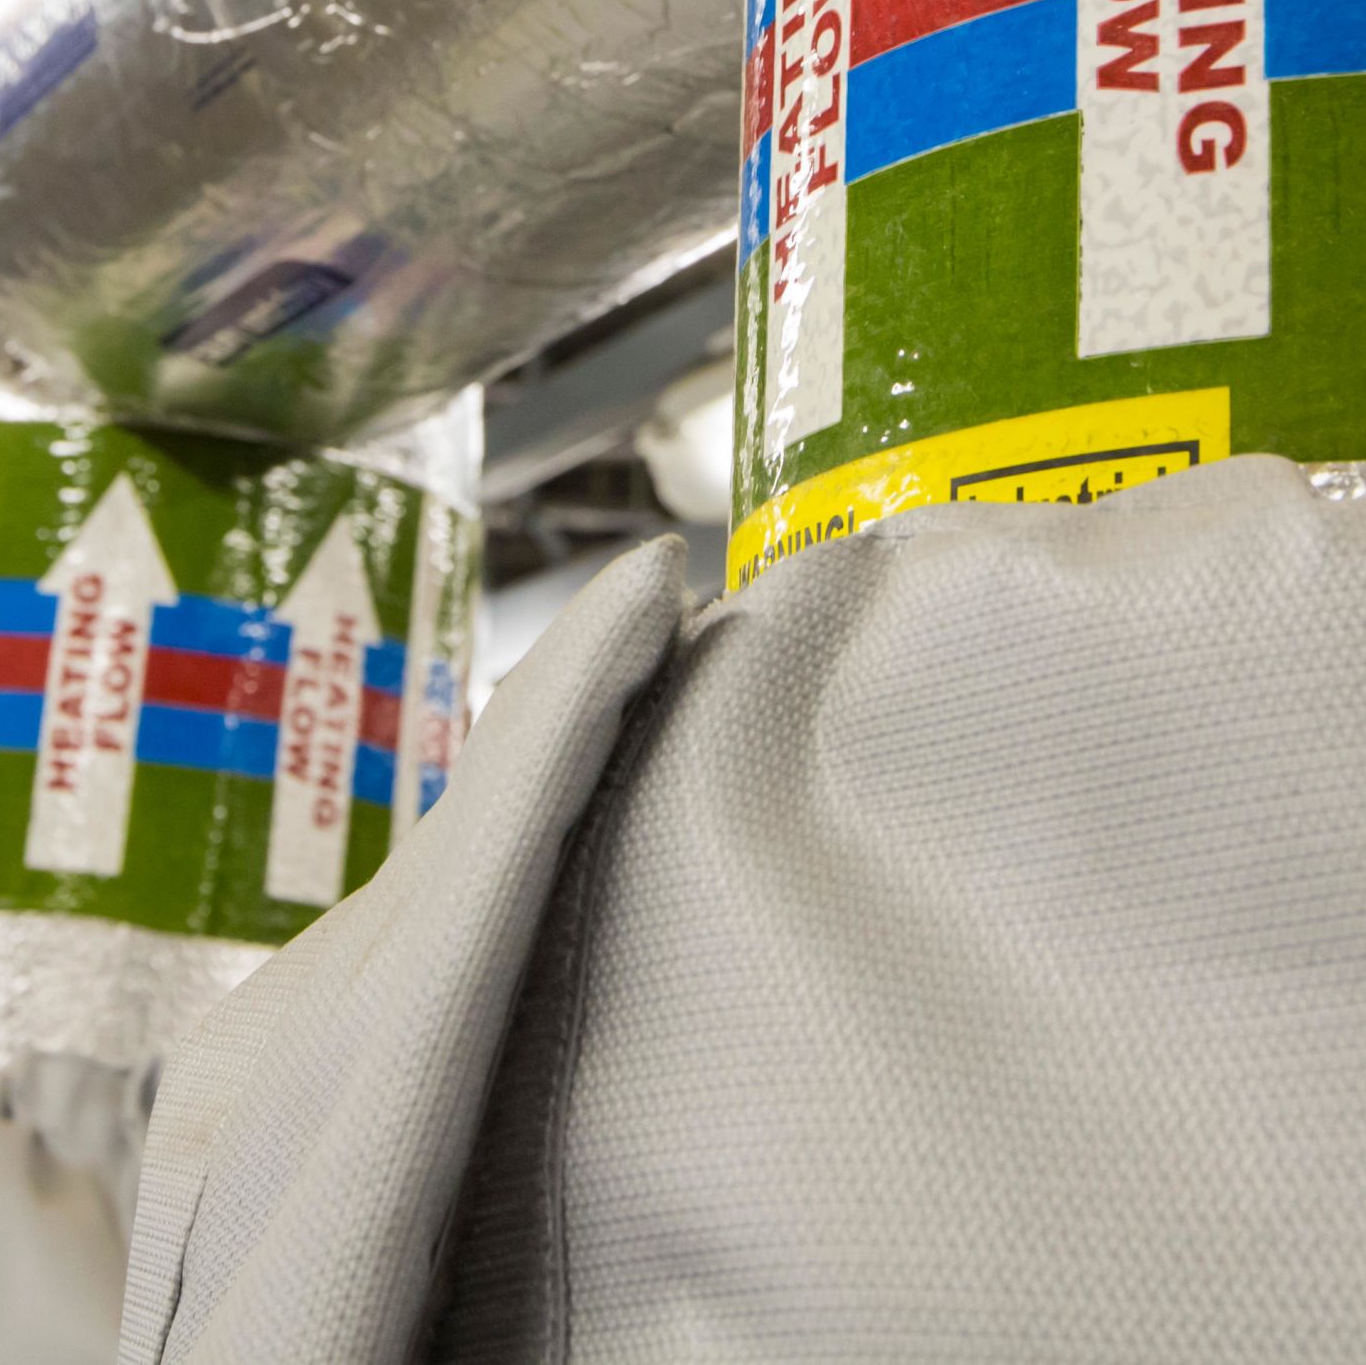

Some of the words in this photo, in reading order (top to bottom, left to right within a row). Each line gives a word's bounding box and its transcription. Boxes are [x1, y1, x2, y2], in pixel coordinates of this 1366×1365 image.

[47, 573, 104, 791] HEATING
[93, 619, 138, 753] FLOW
[285, 646, 323, 781] FLOW
[311, 613, 358, 829] HEATING
